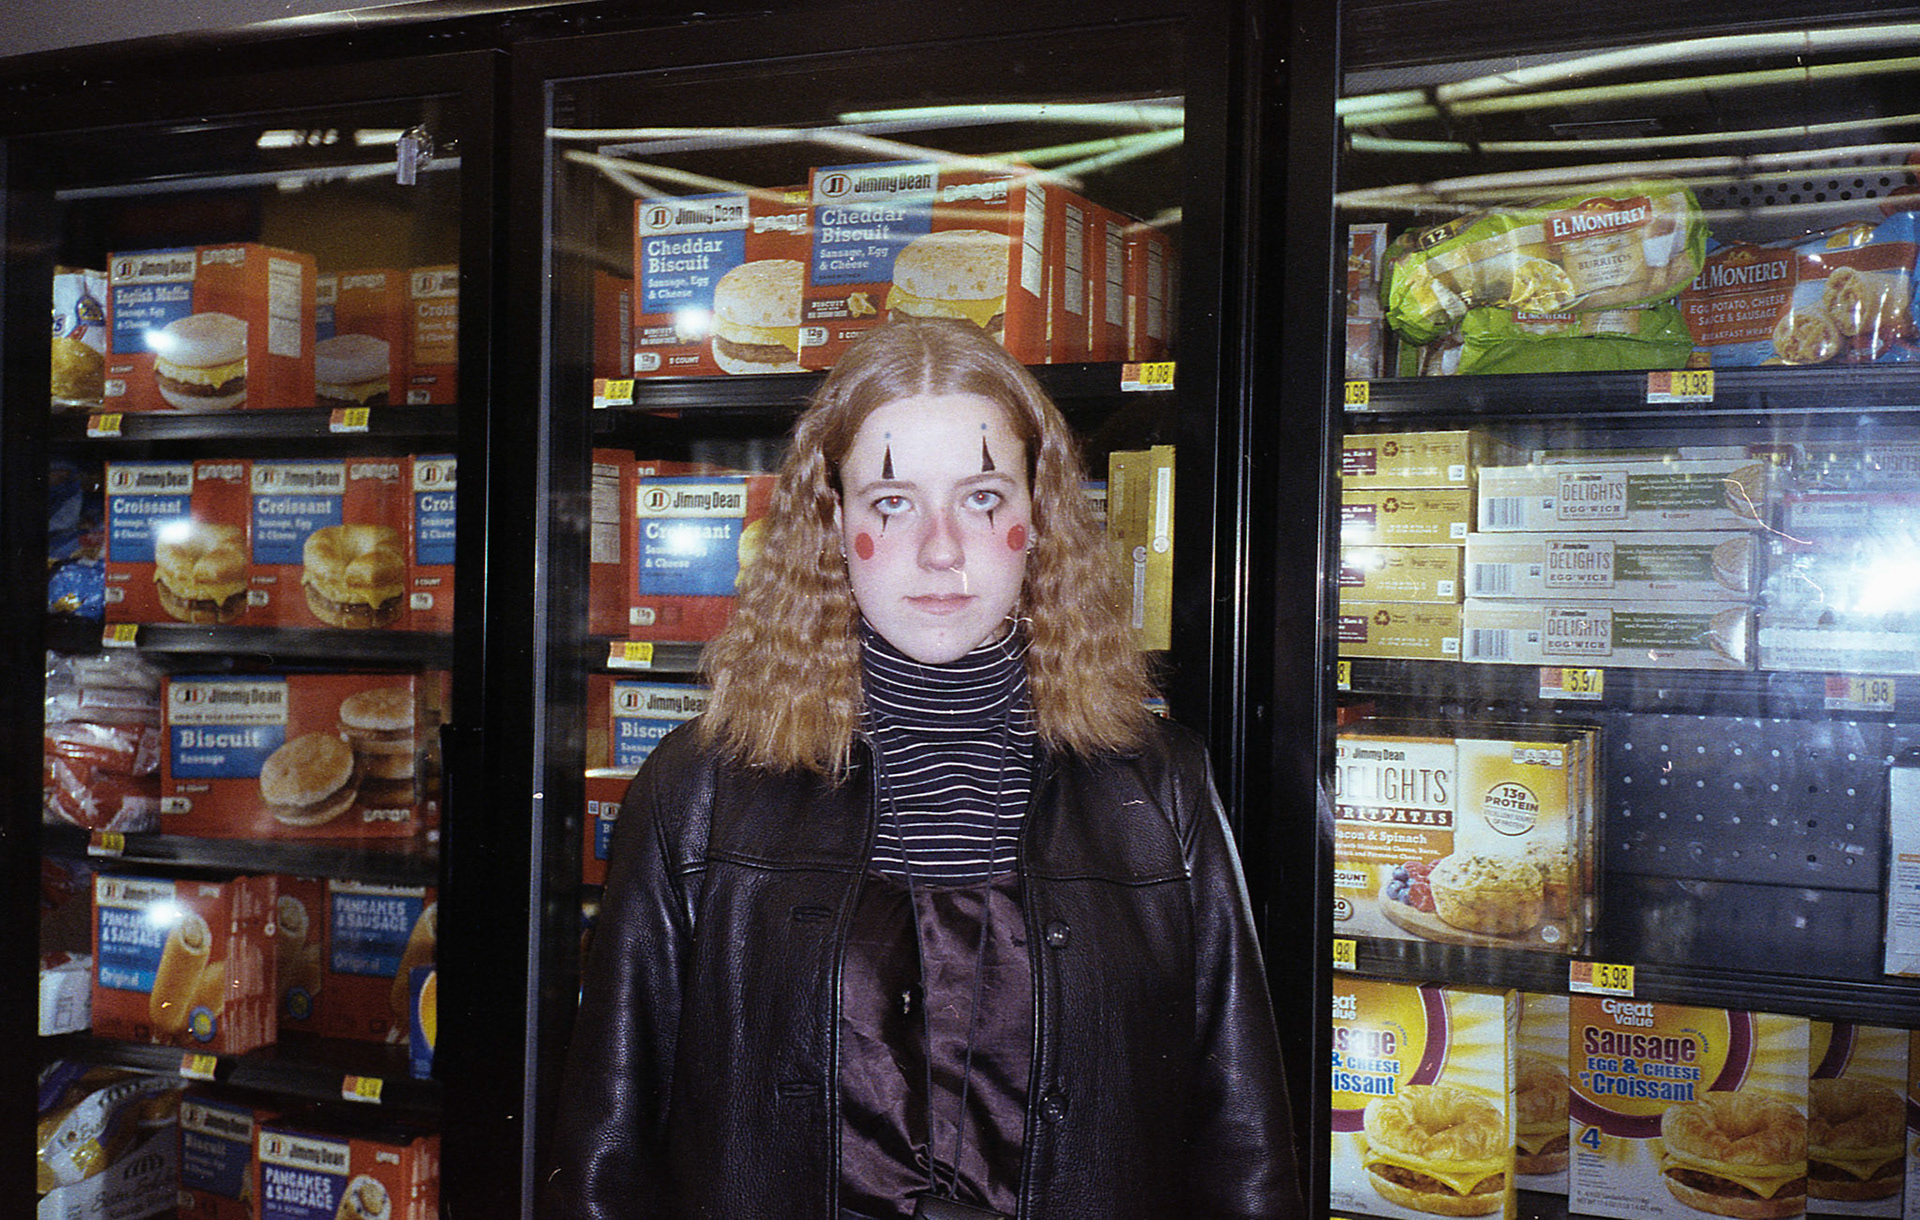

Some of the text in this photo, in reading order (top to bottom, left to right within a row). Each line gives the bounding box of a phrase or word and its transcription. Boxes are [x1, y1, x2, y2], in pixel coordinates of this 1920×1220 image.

[854, 173, 932, 193] Jimmy Dean
[675, 204, 744, 225] Jimmy Dean
[821, 207, 906, 226] Cheddar
[1552, 204, 1648, 237] EL MONTEREY
[820, 225, 891, 244] Biscuit
[1426, 227, 1448, 244] 12
[647, 238, 724, 257] Cheddar
[867, 245, 890, 257] Egg
[648, 255, 710, 274] Biscuit
[818, 258, 870, 271] & Cheese
[1577, 252, 1633, 270] BURRITOS
[647, 275, 710, 289] Sausage, Egg
[1710, 259, 1789, 286] MONTEREY
[647, 288, 694, 300] & Cheese
[1750, 294, 1786, 307] CHEESE
[1735, 307, 1778, 321] SAUSAGE
[806, 328, 824, 340] 12g
[1745, 326, 1773, 338] WRAPS
[675, 355, 700, 365] COUNT
[1680, 373, 1708, 396] 3.98
[673, 490, 741, 510] Jimmy Dean
[1562, 482, 1624, 501] DELIGHTS
[112, 497, 183, 515] Croissant
[257, 497, 332, 515] Croissant
[645, 522, 731, 540] Crant
[1549, 551, 1611, 570] DELIGHTS
[1547, 618, 1609, 637] DELIGHTS
[1569, 669, 1598, 692] 5.97
[208, 688, 282, 705] Jimmy Dean
[1859, 680, 1890, 703] 1.98
[647, 694, 683, 713] Jimmy
[180, 729, 262, 748] Biscuit
[620, 721, 678, 739] Biscui
[179, 753, 226, 766] Sausage
[1352, 747, 1406, 762] Jimmy Dean
[1502, 786, 1527, 801] 13g
[1484, 794, 1540, 813] PROTEIN
[1367, 830, 1378, 841] &
[1380, 831, 1428, 845] Spinach
[335, 896, 407, 915] PANCAKES
[349, 914, 408, 932] SAUSAGE
[110, 928, 162, 948] SAUSAGE
[1600, 965, 1629, 990] 5.98
[1601, 998, 1655, 1018] Great
[1613, 1013, 1654, 1028] Value
[1333, 1027, 1396, 1058] sage
[1583, 1025, 1697, 1065] Sausage
[1346, 1057, 1400, 1074] CHEESE
[1587, 1057, 1701, 1081] EGG & CHEESE
[1592, 1072, 1695, 1102] Croissant
[1580, 1126, 1602, 1150] 4
[265, 1167, 332, 1195] PANCAKES
[265, 1183, 334, 1212] & SAUSAGE
